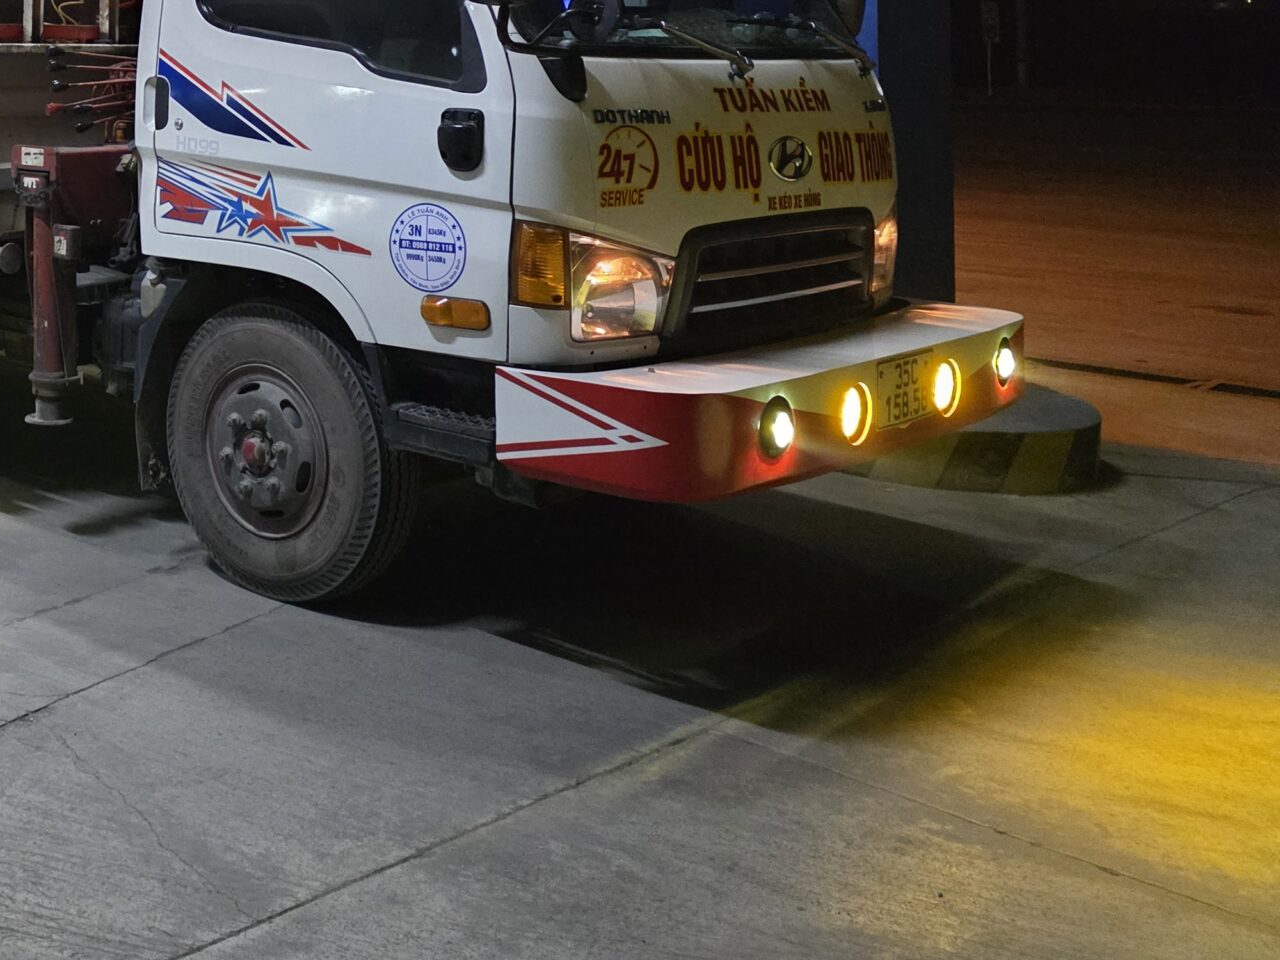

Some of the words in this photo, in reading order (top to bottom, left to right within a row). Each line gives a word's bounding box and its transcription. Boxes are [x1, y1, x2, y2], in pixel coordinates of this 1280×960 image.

[597, 143, 636, 184] 247
[676, 122, 727, 192] CỨU
[730, 122, 762, 203] HỘ
[817, 130, 854, 183] GIAO
[600, 188, 645, 208] SERVICE
[767, 195, 778, 212] XE
[778, 191, 793, 211] KÉO
[793, 193, 803, 209] XE
[408, 224, 422, 238] 3N
[895, 358, 919, 390] 35C
